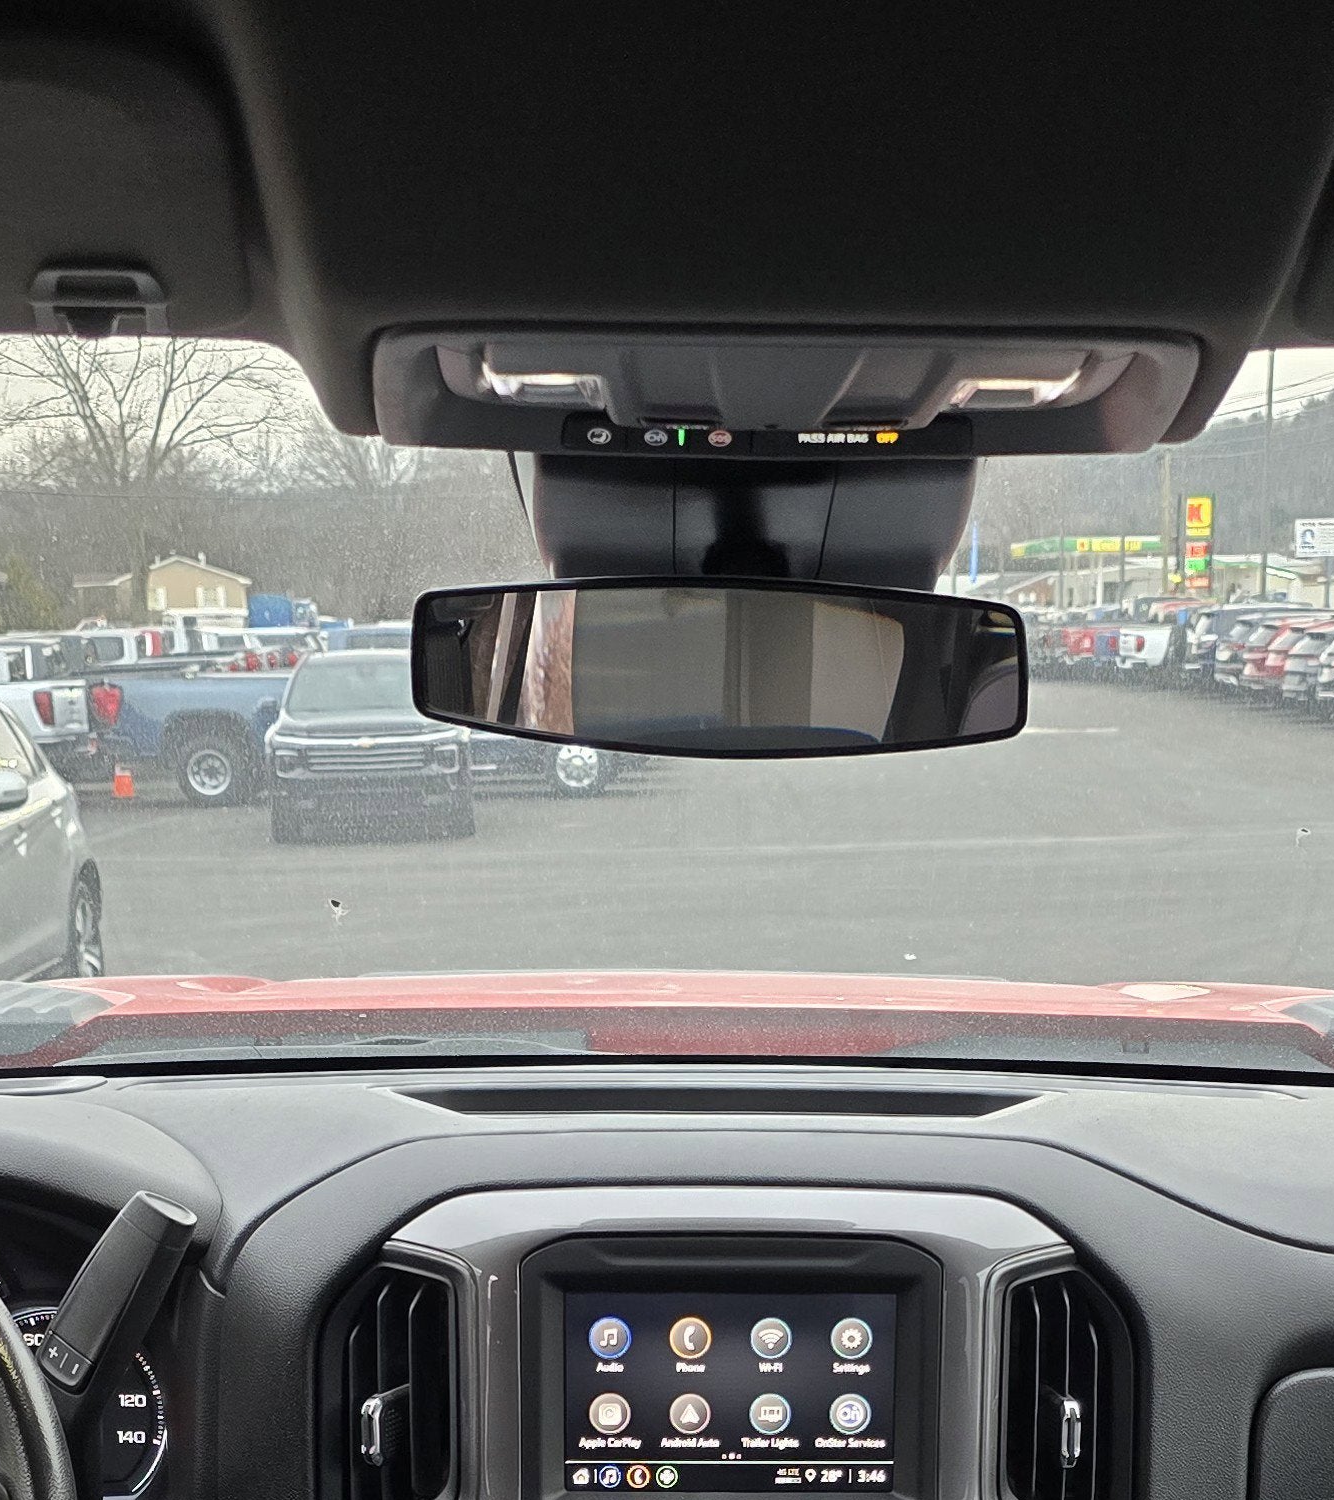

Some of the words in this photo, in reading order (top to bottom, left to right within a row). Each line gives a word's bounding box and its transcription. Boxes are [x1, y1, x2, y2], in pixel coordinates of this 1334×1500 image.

[798, 432, 825, 444] PASS
[827, 432, 845, 444] AIR
[847, 432, 869, 444] BAG
[876, 431, 900, 444] OFF
[596, 1362, 624, 1373] Audio
[675, 1362, 705, 1373] Phone
[832, 1362, 870, 1376] Settings
[118, 1394, 147, 1408] 120
[117, 1430, 147, 1444] 140
[579, 1437, 606, 1450] Apple
[607, 1437, 642, 1450] CarPlay
[661, 1437, 692, 1449] Android
[693, 1437, 720, 1449] Auto
[741, 1437, 771, 1449] Trailer
[772, 1437, 799, 1450] Lights
[815, 1437, 847, 1449] OnStar
[848, 1437, 886, 1449] Services
[857, 1469, 886, 1483] 3:46
